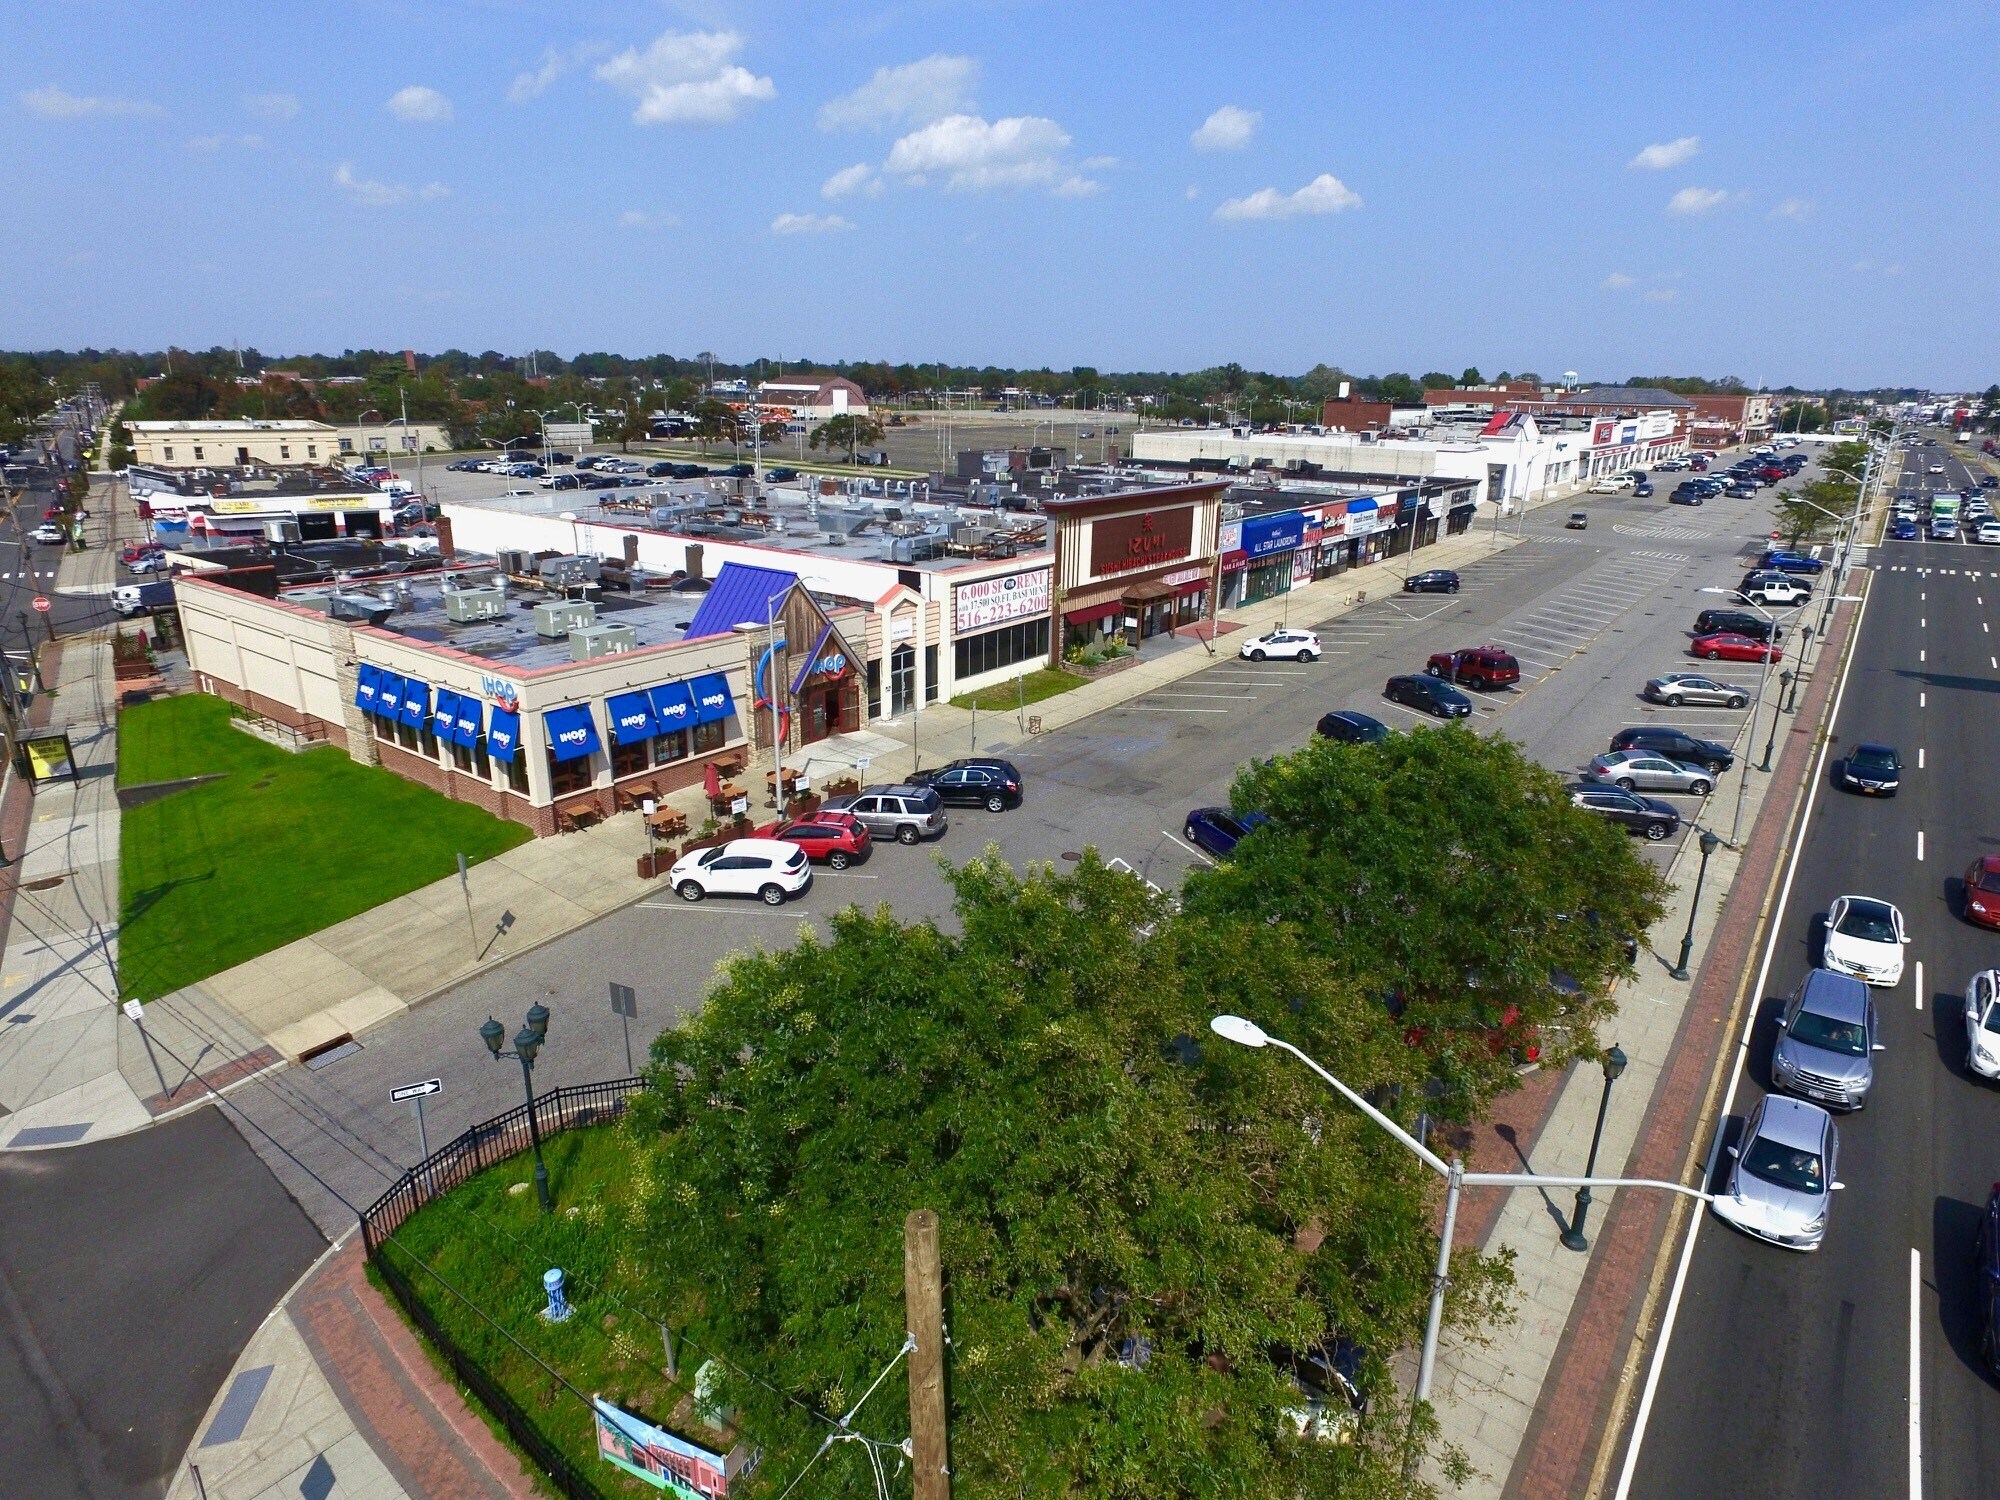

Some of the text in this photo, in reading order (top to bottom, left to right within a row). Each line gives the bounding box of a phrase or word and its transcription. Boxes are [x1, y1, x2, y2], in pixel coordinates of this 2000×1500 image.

[1254, 543, 1262, 553] ALL
[1263, 540, 1273, 550] STAR
[1101, 562, 1121, 574] SUSHI
[1122, 556, 1147, 570] HIBACHI
[961, 582, 990, 601] 6,000
[992, 580, 1003, 594] SF
[1016, 571, 1044, 589] RENT
[1012, 585, 1046, 600] BASEMENT
[958, 594, 1047, 630] 516-223-6200
[360, 685, 374, 696] IHOP
[482, 676, 516, 704] IHOP
[382, 693, 397, 704] IHOP
[702, 694, 724, 706] IHOP
[406, 701, 422, 713] IHOP
[662, 703, 686, 716] IHOP
[436, 711, 453, 724] IHOP
[621, 713, 646, 727] IHOP
[458, 719, 475, 732] IHOP
[492, 730, 511, 744] IHOP
[560, 728, 587, 742] IHOP
